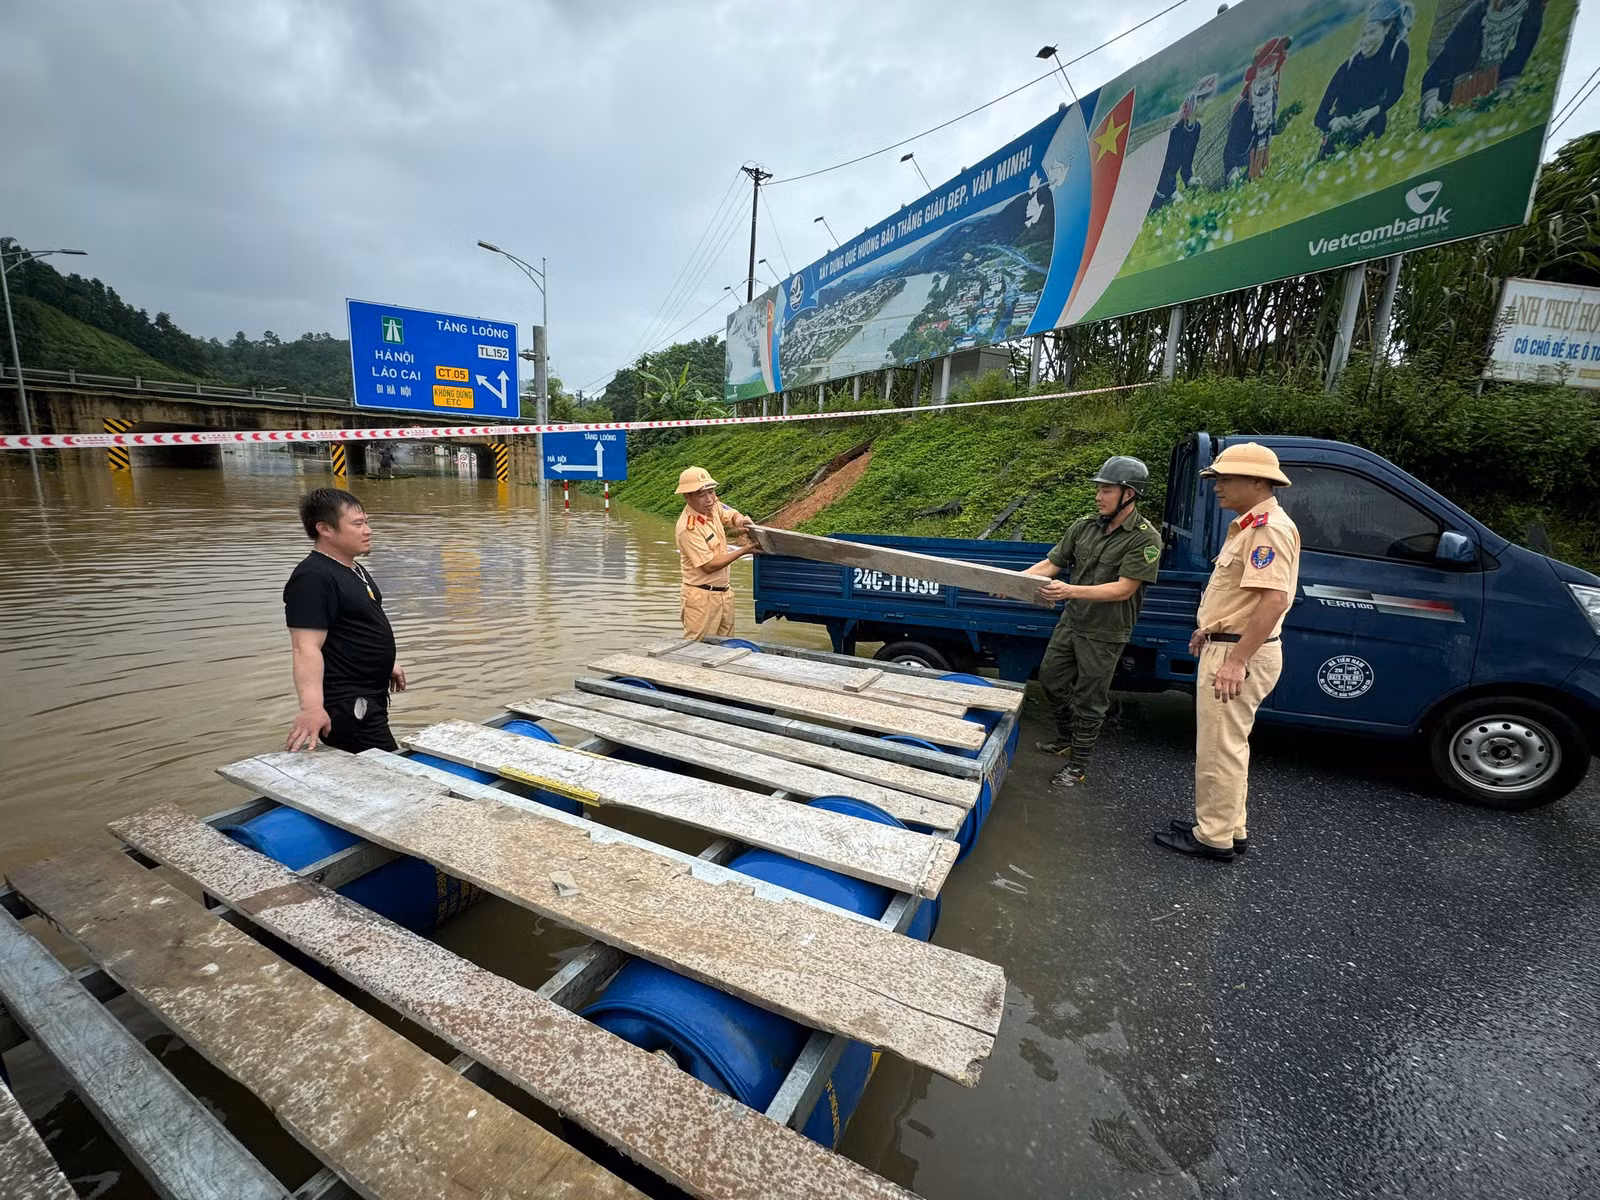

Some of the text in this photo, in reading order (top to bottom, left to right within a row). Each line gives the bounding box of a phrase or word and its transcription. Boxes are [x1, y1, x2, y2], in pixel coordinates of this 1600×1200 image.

[924, 196, 946, 223] GIÀU
[947, 184, 969, 212] ĐẸP,
[972, 167, 994, 198] VĂN
[995, 144, 1033, 185] MINH!
[1308, 206, 1452, 257] Vietcombank
[479, 347, 508, 359] TL.152
[1513, 335, 1529, 354] CÓ
[1529, 334, 1552, 356] CHỖ
[1565, 343, 1580, 359] XE
[1581, 341, 1590, 360] Ô
[372, 365, 421, 381] LÀO CAI
[438, 368, 466, 380] CT.05
[386, 384, 396, 395] HÀ
[434, 387, 455, 398] KHÔNG
[446, 398, 462, 406] ETC
